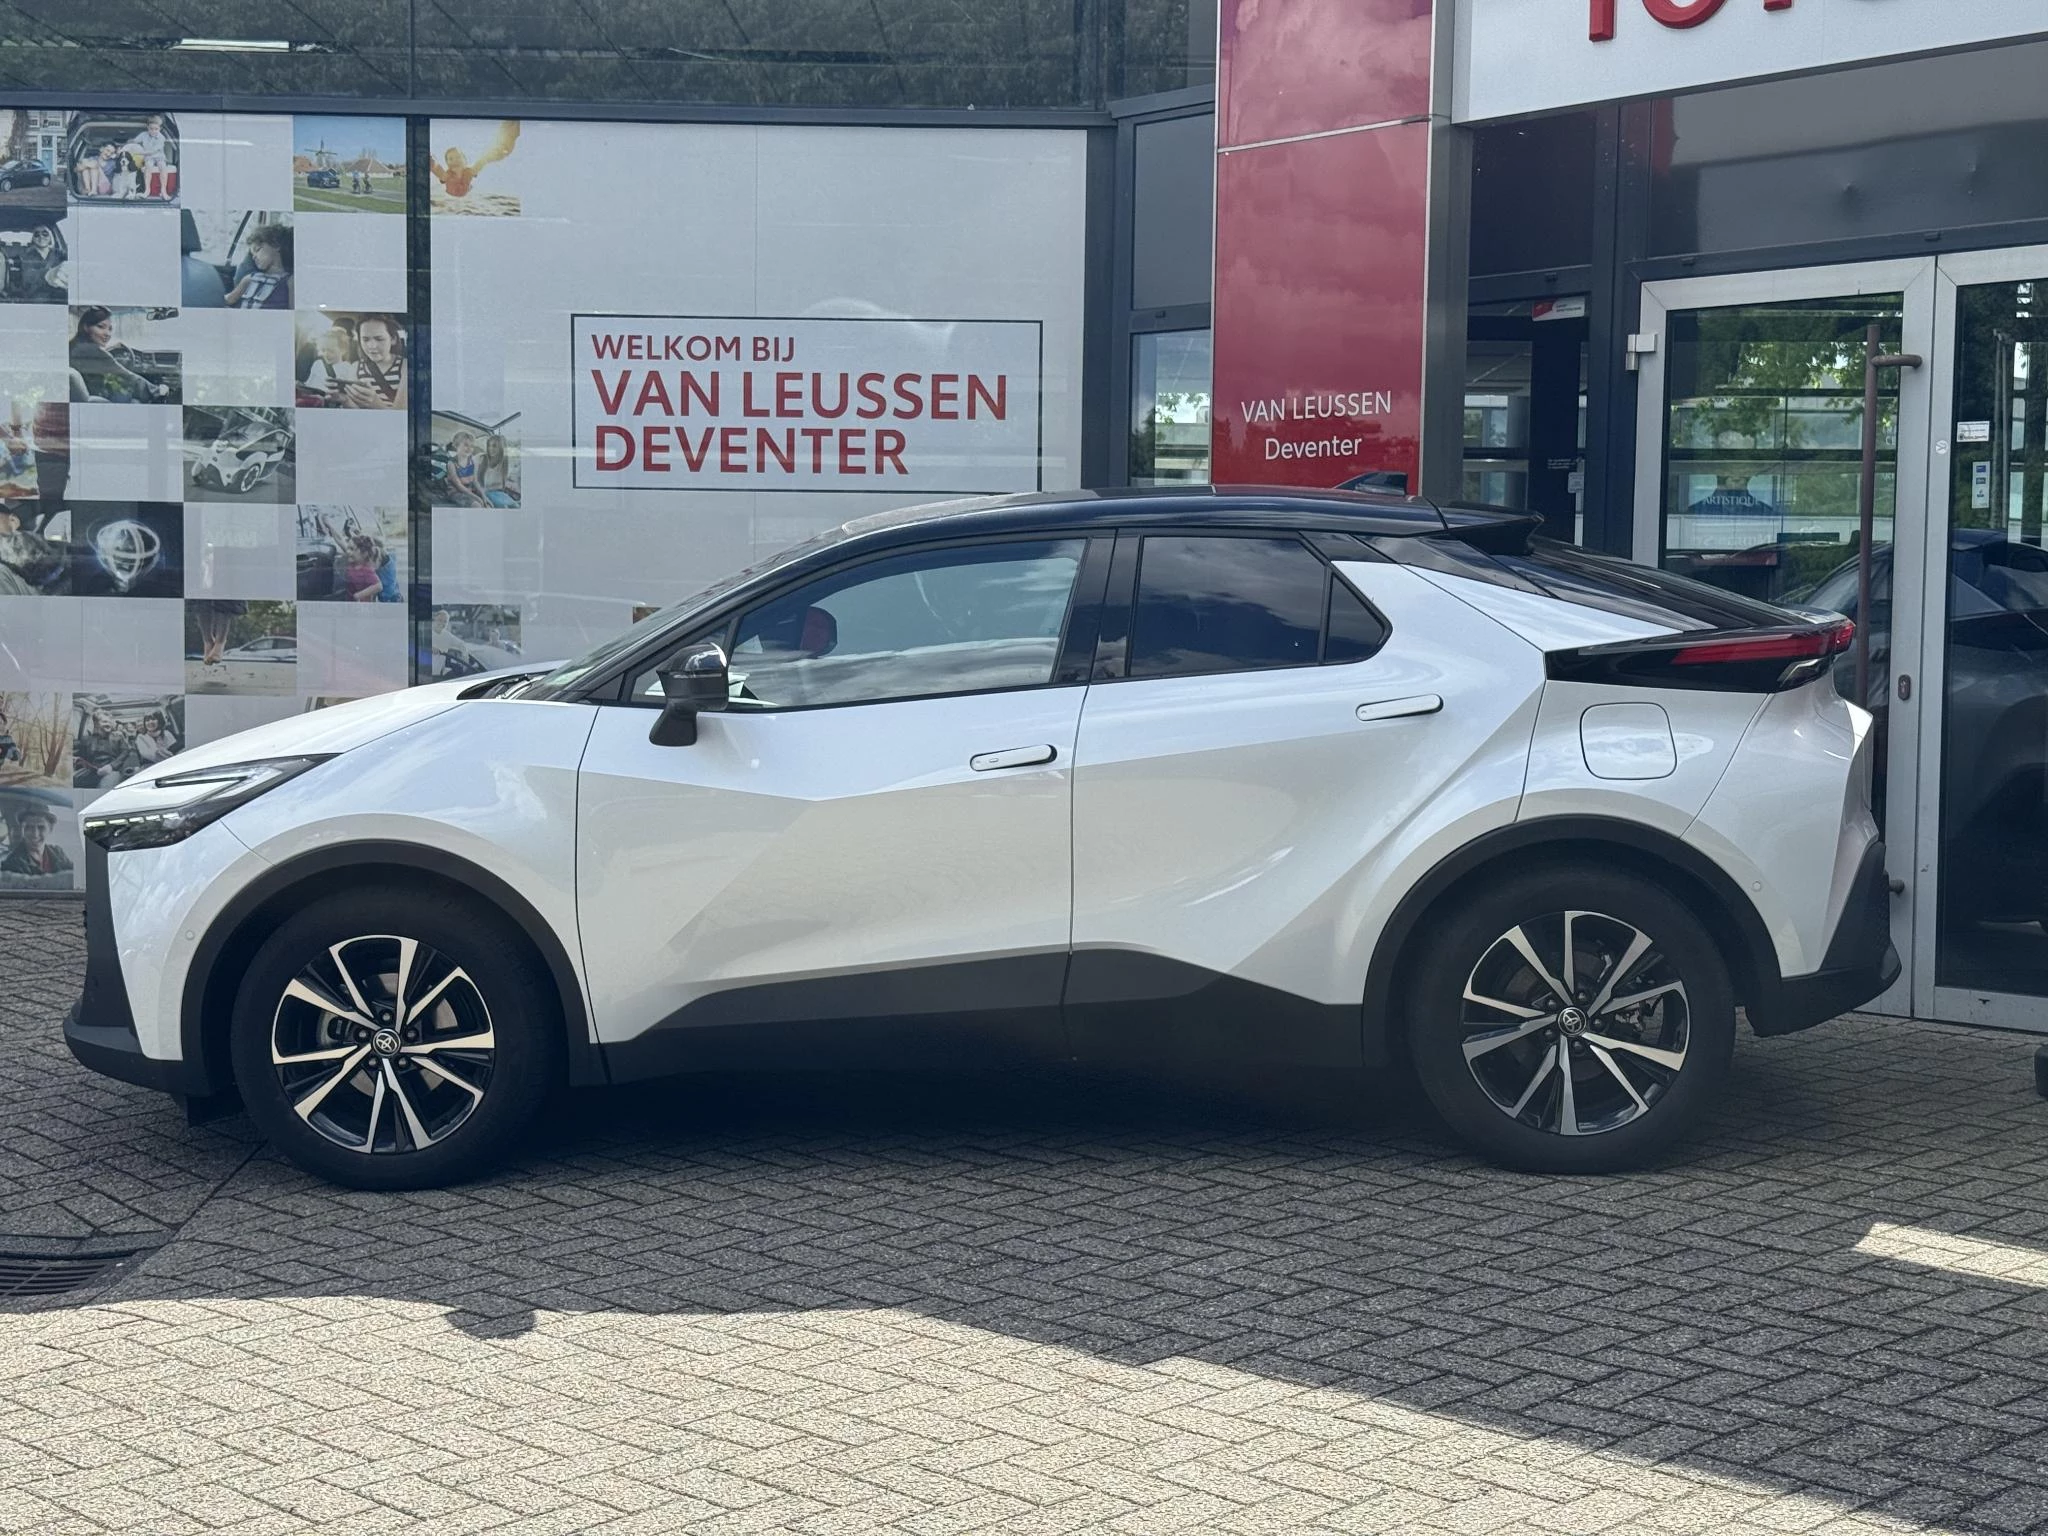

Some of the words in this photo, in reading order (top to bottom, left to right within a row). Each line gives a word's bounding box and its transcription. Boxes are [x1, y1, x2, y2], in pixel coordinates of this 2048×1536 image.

[591, 334, 741, 361] WELKOM
[753, 336, 795, 362] BIJ
[591, 369, 720, 417] VAN
[743, 371, 1007, 421] LEUSSEN
[1241, 398, 1286, 423] VAN
[1293, 390, 1392, 420] LEUSSEN
[595, 425, 909, 475] DEVENTER
[1265, 435, 1362, 460] Deventer
